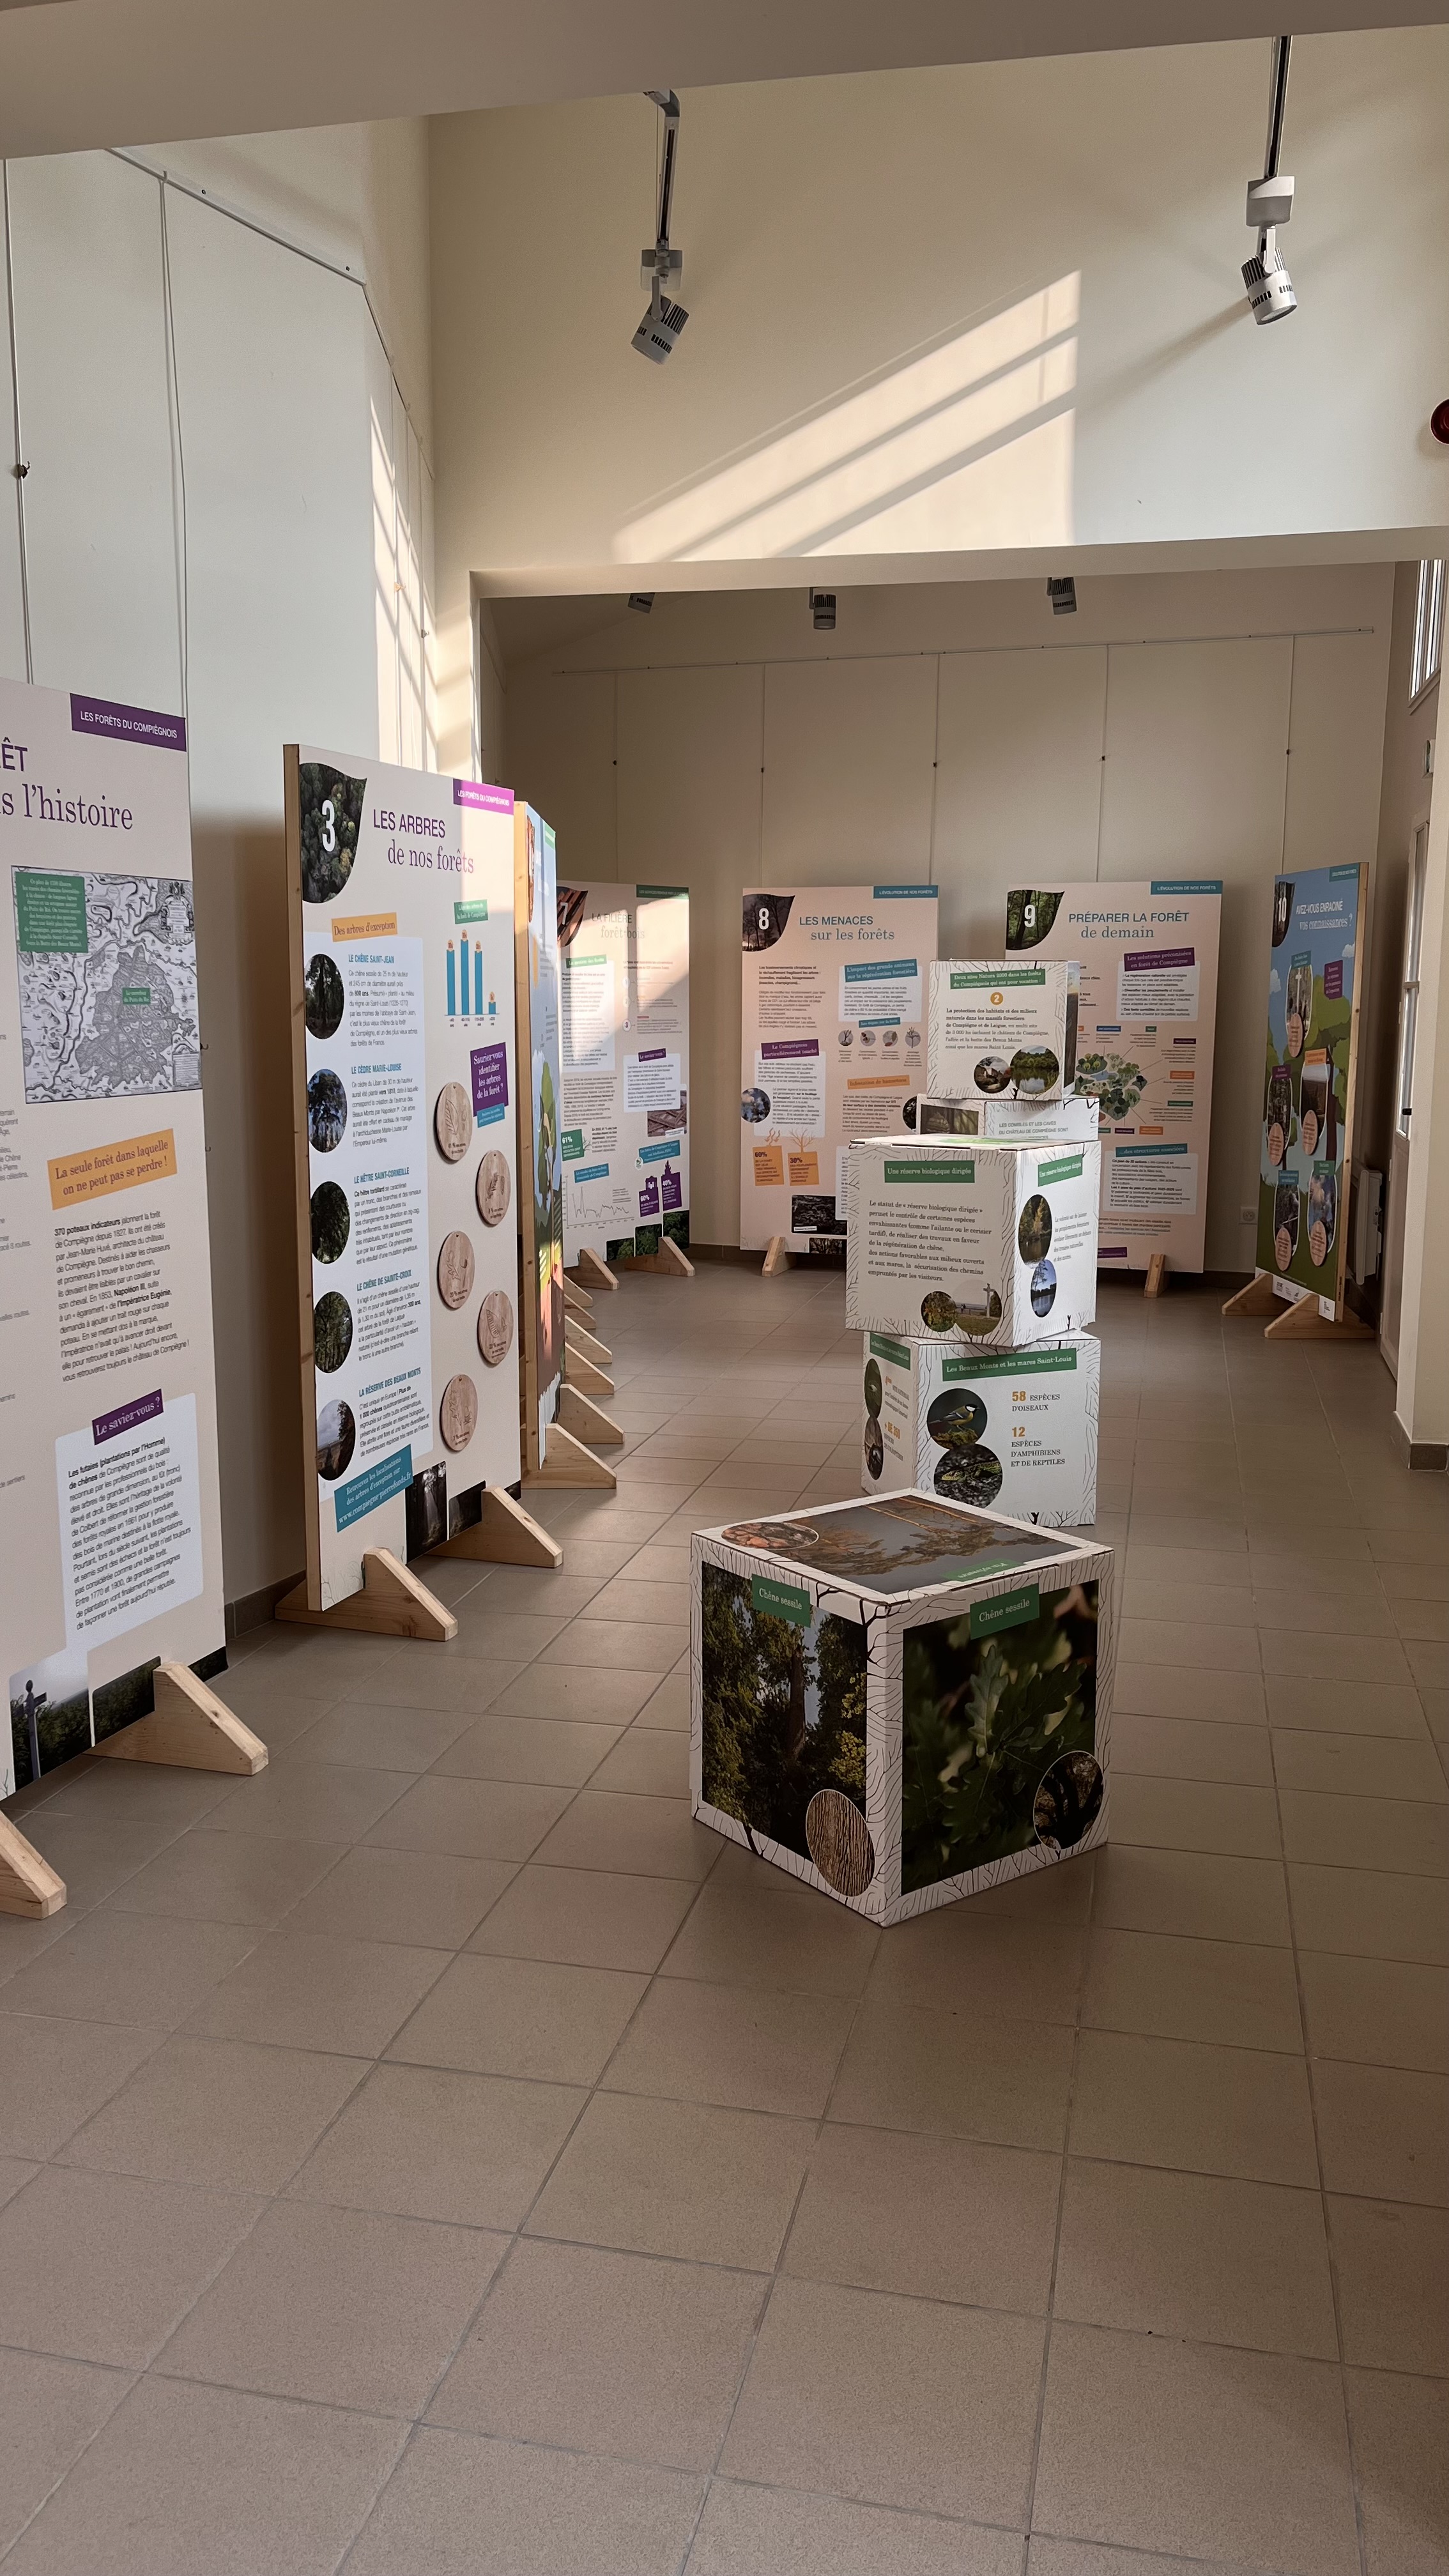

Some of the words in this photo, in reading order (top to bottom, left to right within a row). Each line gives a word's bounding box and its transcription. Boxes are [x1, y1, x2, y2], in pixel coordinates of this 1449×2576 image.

[80, 710, 93, 721] LES
[95, 713, 121, 727] FORÊTS
[122, 719, 132, 729] DU
[133, 721, 177, 738] COMPIÉGNOIS
[0, 737, 27, 771] ÊT
[21, 783, 133, 829] l'histoire
[321, 799, 335, 852] 3
[373, 809, 395, 831] LES
[399, 813, 445, 838] ARBRES
[387, 838, 404, 865] de
[408, 850, 433, 868] nos
[436, 845, 473, 873] forêts
[560, 902, 568, 924] 7
[1278, 897, 1286, 922] 10
[592, 912, 602, 922] LA
[604, 912, 632, 924] FILIÈRE
[758, 908, 769, 930] 8
[799, 916, 818, 925] LES
[822, 916, 873, 925] MENACES
[1024, 905, 1036, 928] 9
[1068, 910, 1129, 923] PRÉPARER
[1133, 912, 1147, 922] LA
[1150, 910, 1189, 922] FORÊT
[334, 925, 346, 937] Des
[346, 924, 365, 934] arbres
[365, 919, 395, 932] d'exception
[810, 931, 832, 940] sur
[836, 928, 853, 940] les
[857, 927, 894, 940] forêts
[1080, 926, 1096, 938] de
[1101, 925, 1154, 938] demain
[993, 994, 1000, 1002] 2
[486, 1075, 501, 1085] arbres
[55, 1167, 68, 1179] La
[69, 1160, 92, 1176] seule
[94, 1154, 114, 1169] forêt
[115, 1150, 135, 1162] dans
[136, 1139, 168, 1157] laquelle
[63, 1185, 74, 1195] on
[75, 1181, 87, 1192] ne
[88, 1173, 108, 1190] peut
[109, 1170, 124, 1184] pas
[125, 1168, 135, 1177] se
[135, 1158, 162, 1176] perdre
[164, 1155, 167, 1166] !
[921, 1167, 950, 1176] biologique
[928, 1203, 957, 1212] biologique
[958, 1206, 978, 1214] dirigée
[882, 1240, 917, 1248] régénération
[899, 1251, 927, 1259] favorables
[914, 1262, 947, 1271] sécurisation
[1036, 1355, 1071, 1364] Saint-Louis
[1012, 1390, 1025, 1401] 58
[1029, 1393, 1060, 1401] ESPÈCES
[95, 1424, 107, 1436] Le
[109, 1402, 155, 1430] saviez-vous
[155, 1396, 160, 1407] ?
[1011, 1426, 1025, 1437] 12
[1011, 1439, 1041, 1447] ESPÈCES
[1010, 1449, 1061, 1457] D'AMPHIBIENS
[758, 1587, 779, 1602] Chêne
[780, 1597, 802, 1609] sessile
[979, 1609, 1003, 1621] Chêne
[1005, 1599, 1029, 1613] sessile
